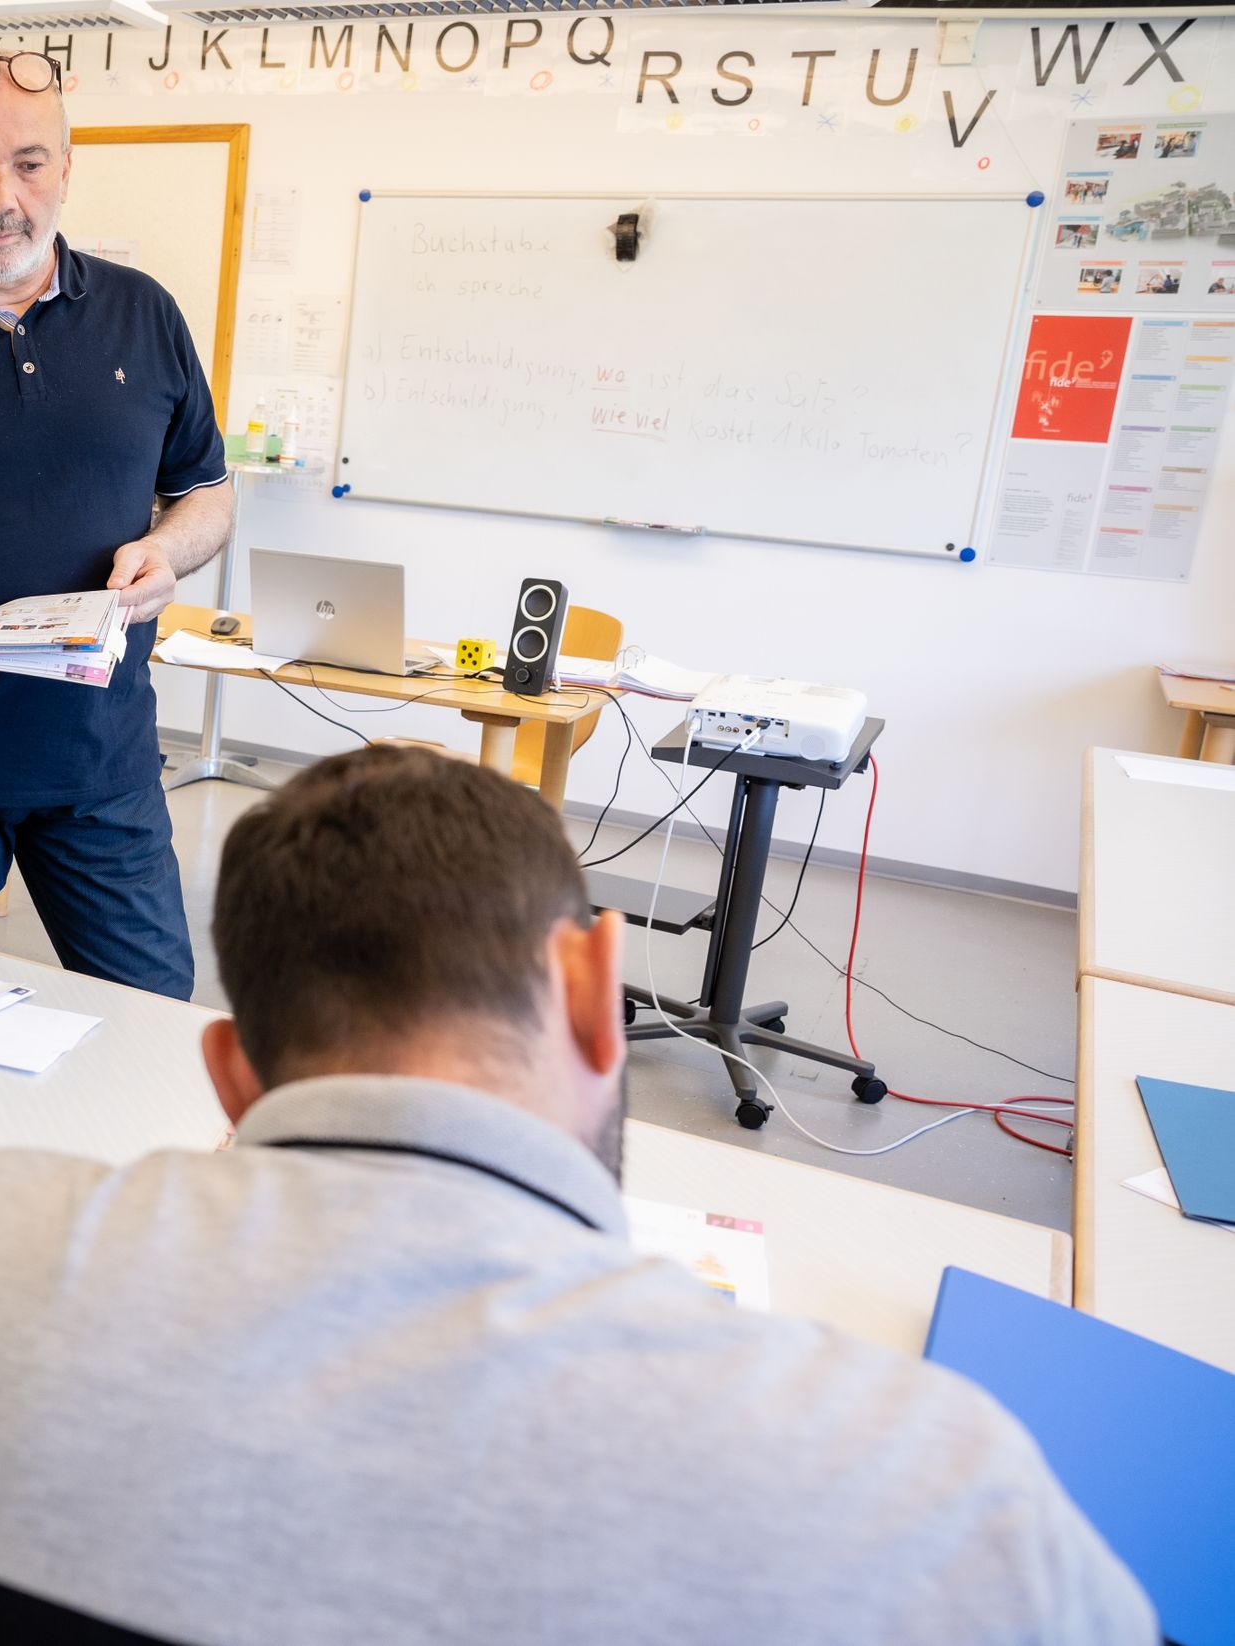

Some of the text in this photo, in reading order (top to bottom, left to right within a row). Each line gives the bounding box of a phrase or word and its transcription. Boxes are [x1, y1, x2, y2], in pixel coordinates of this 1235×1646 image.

[44, 34, 73, 71] H
[105, 32, 113, 71] I
[148, 24, 172, 72] J
[200, 29, 233, 71] K
[259, 27, 287, 69] L
[308, 24, 354, 69] M
[373, 22, 415, 74] N
[435, 21, 480, 73] O
[502, 18, 544, 70] P
[567, 15, 616, 68] Q
[635, 50, 684, 105] R
[711, 50, 757, 107] S
[790, 49, 837, 107] T
[865, 47, 919, 107] U
[942, 89, 998, 148] V
[1030, 20, 1116, 87] W
[1122, 17, 1199, 86] X
[316, 600, 335, 620] hp
